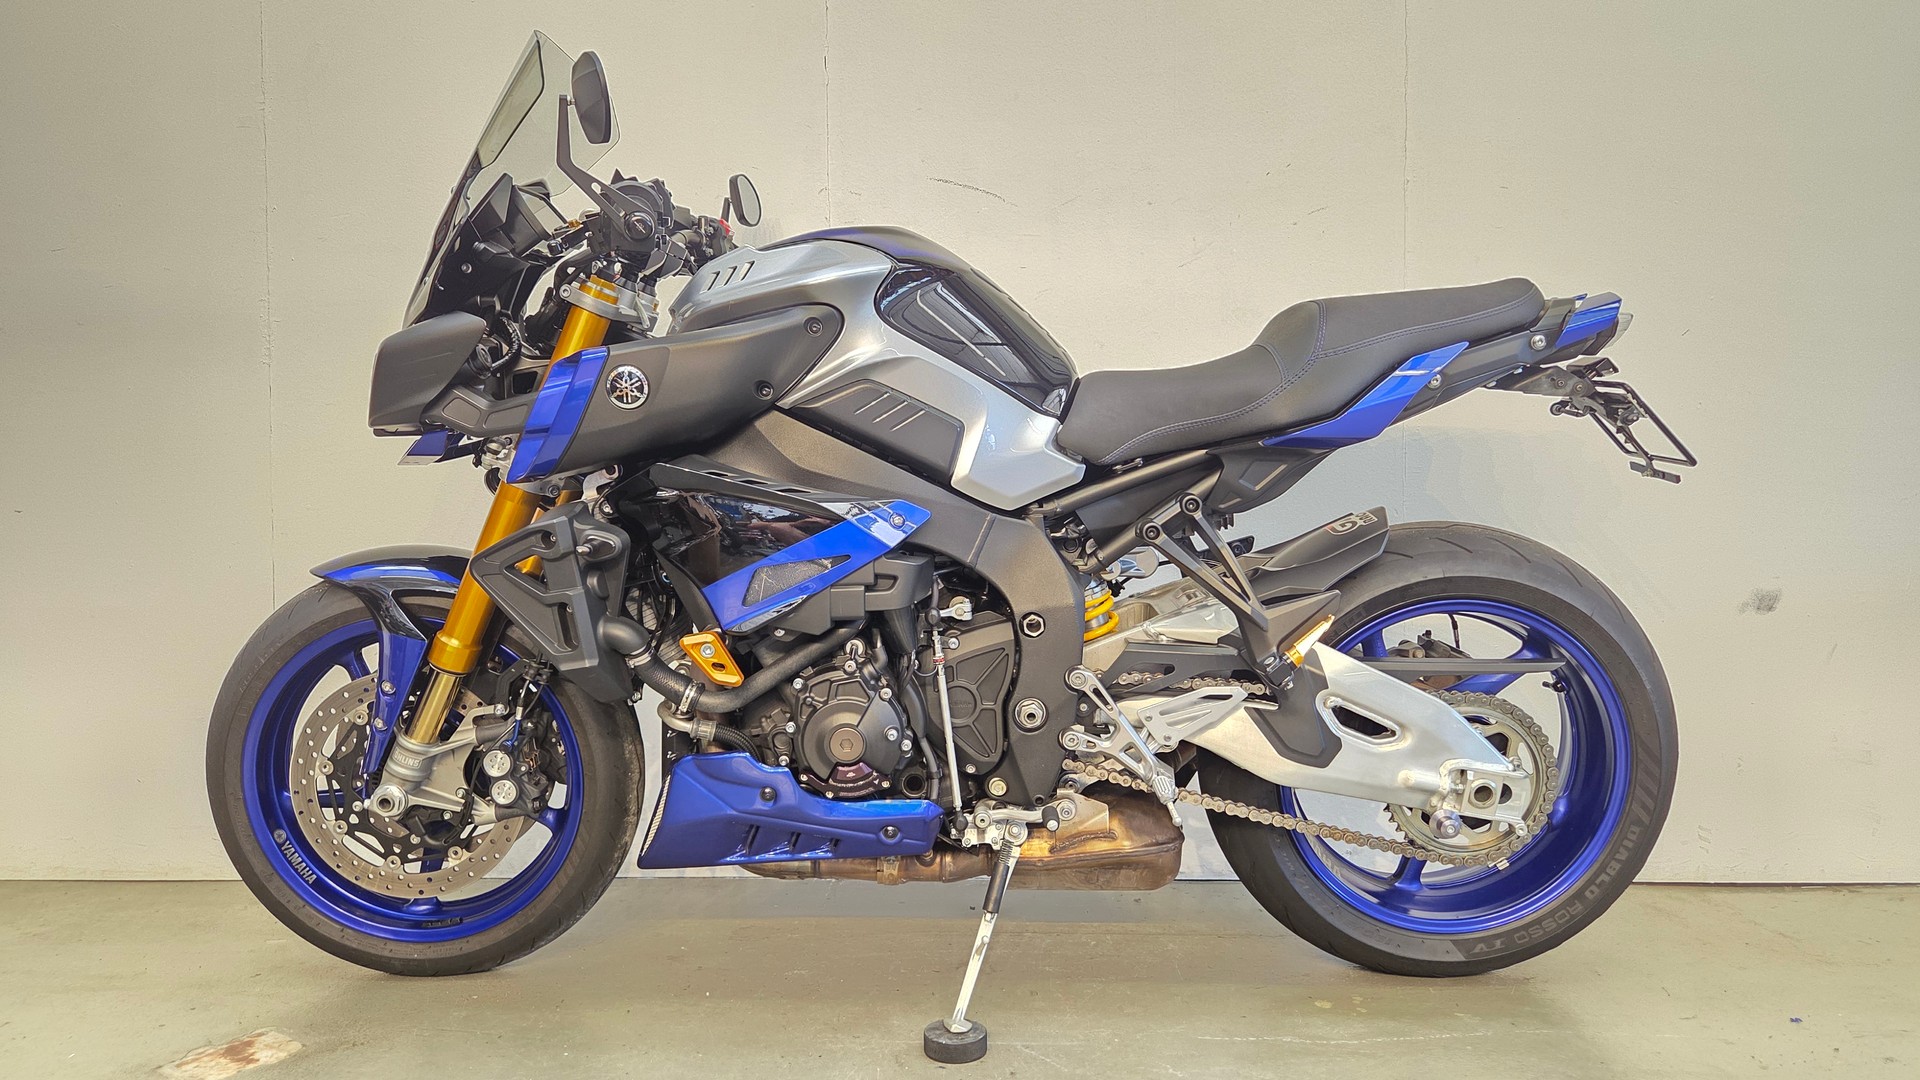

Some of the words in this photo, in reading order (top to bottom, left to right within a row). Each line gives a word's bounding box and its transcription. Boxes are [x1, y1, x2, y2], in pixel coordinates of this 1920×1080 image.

[281, 840, 317, 884] YAMAHA
[1584, 824, 1641, 900] DIABLO
[1514, 900, 1583, 944] ROSSO
[1470, 938, 1506, 953] IV
